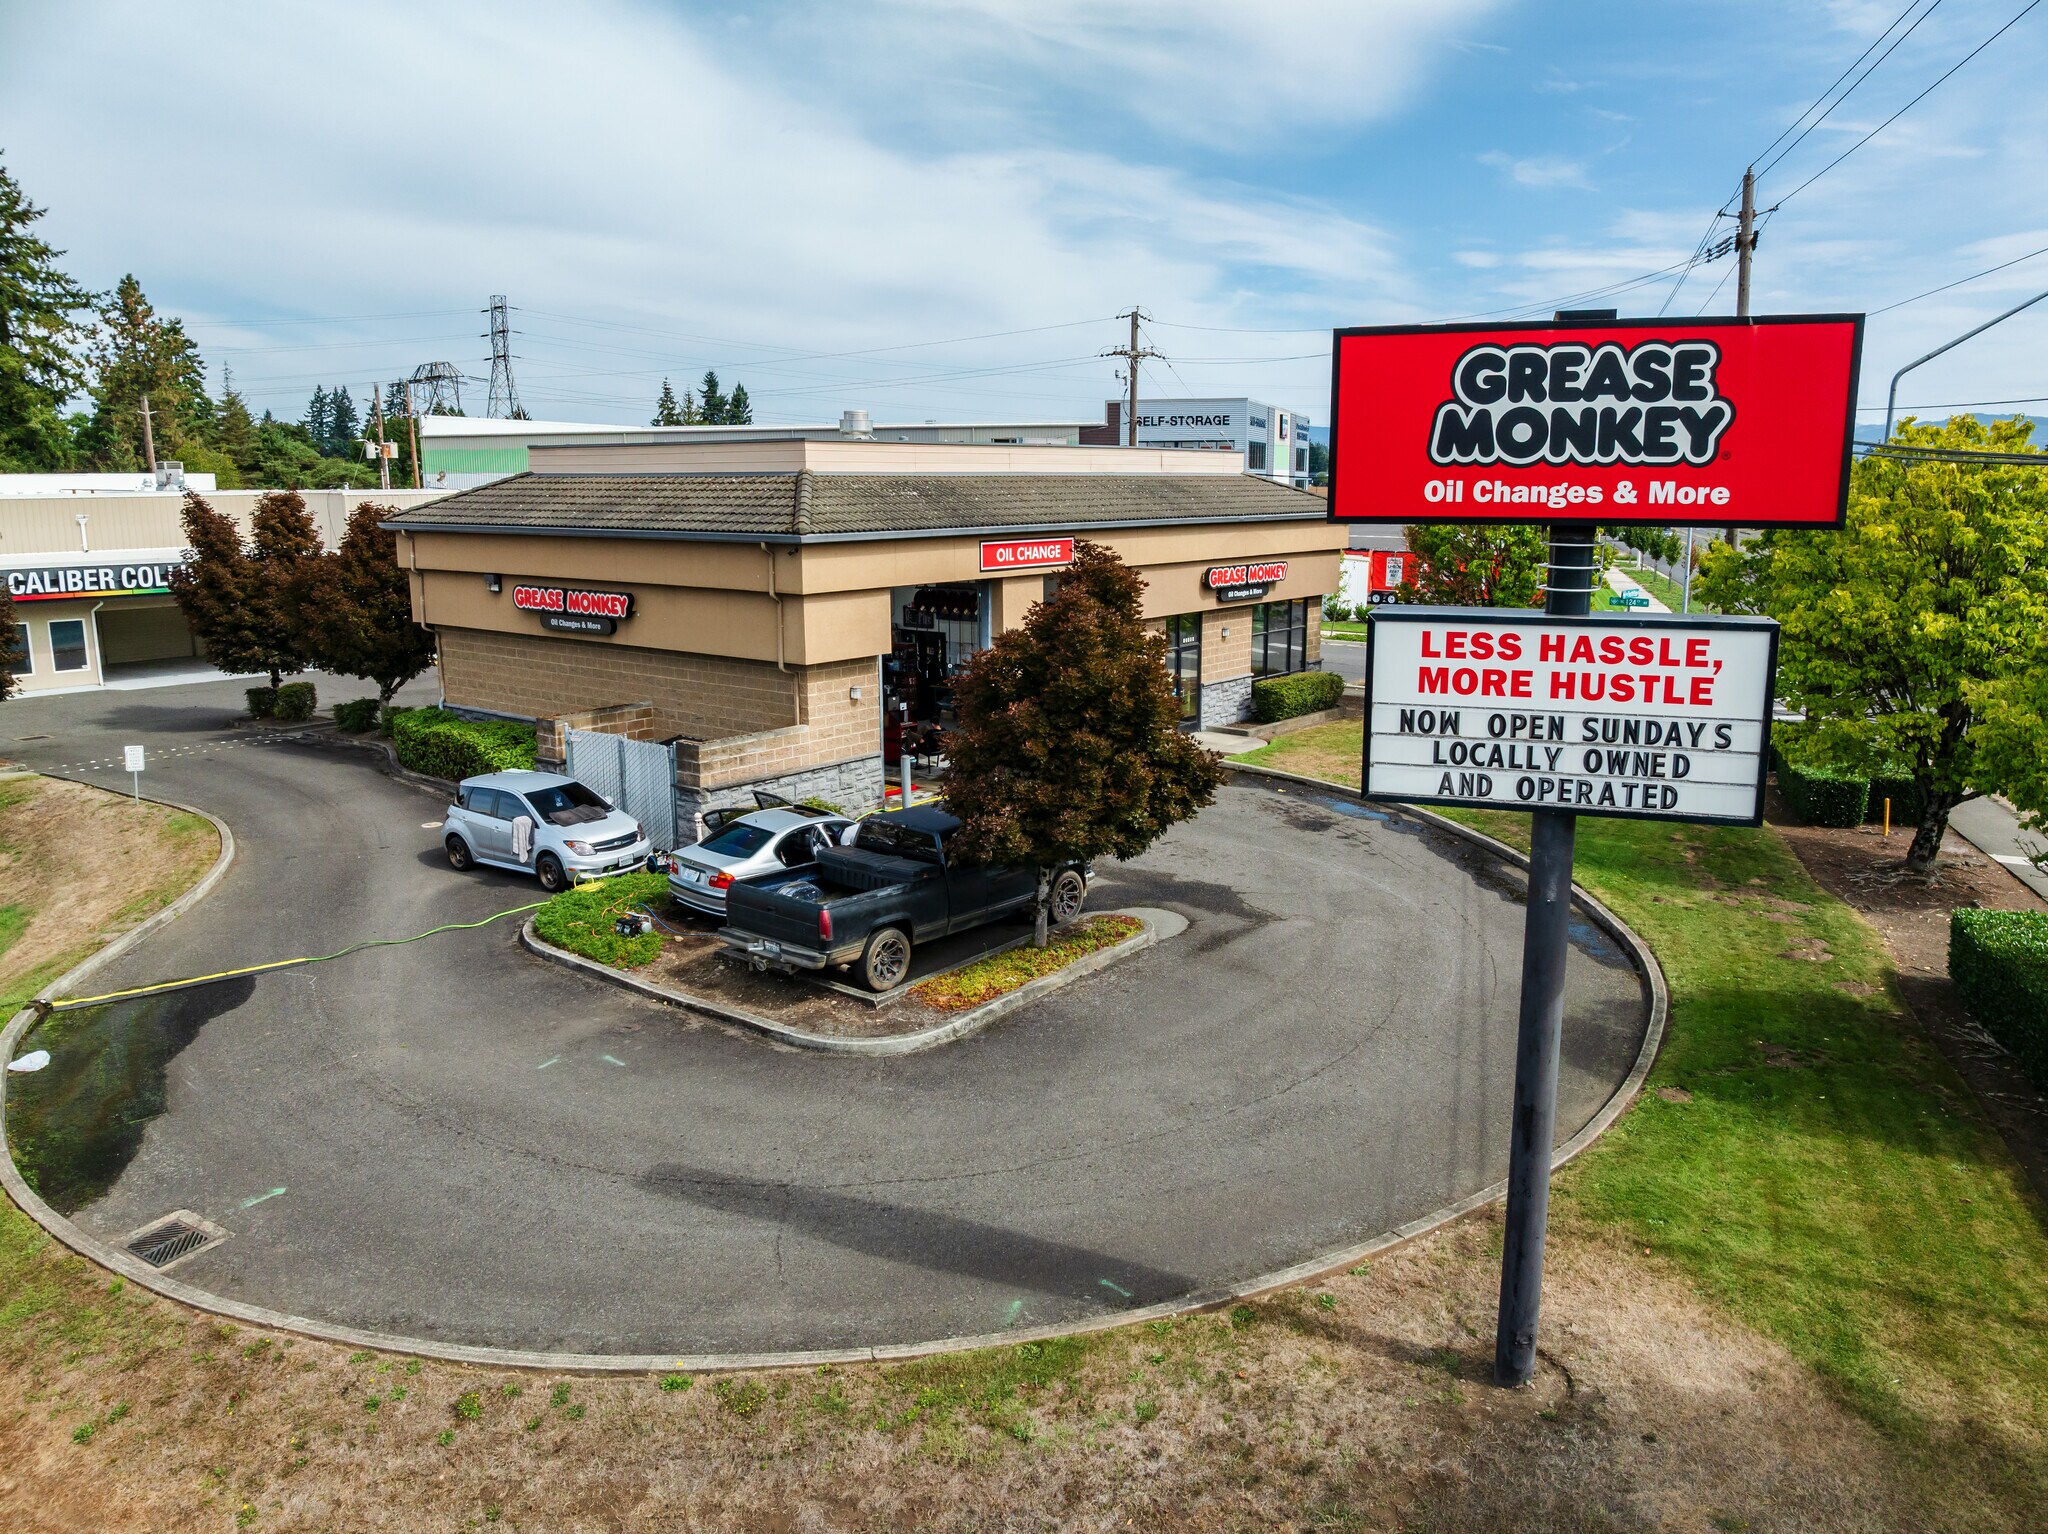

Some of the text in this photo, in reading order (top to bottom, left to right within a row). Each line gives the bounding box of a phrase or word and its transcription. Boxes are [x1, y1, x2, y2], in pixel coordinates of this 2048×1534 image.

[1459, 348, 1713, 405] GREASE
[1136, 415, 1231, 427] SELF-STORAGE
[1435, 405, 1727, 459] MONKEY
[1424, 479, 1730, 509] Oil Changes & More
[996, 545, 1061, 562] OIL CHANGE
[8, 568, 116, 595] CALIBER
[1209, 562, 1287, 588] GREASE MONKEY
[513, 586, 628, 617] GREASE MONKEY
[559, 619, 580, 629] Changes
[582, 621, 586, 629] &
[587, 621, 601, 630] More
[1421, 631, 1724, 675] LESS HASSLE,
[1418, 666, 1715, 706] MORE HUSTLE
[1400, 709, 1733, 749] NOW OPEN SUNDAYS
[1433, 740, 1691, 779] LOCALLY OWNED
[1438, 771, 1679, 809] AND OPERATED
